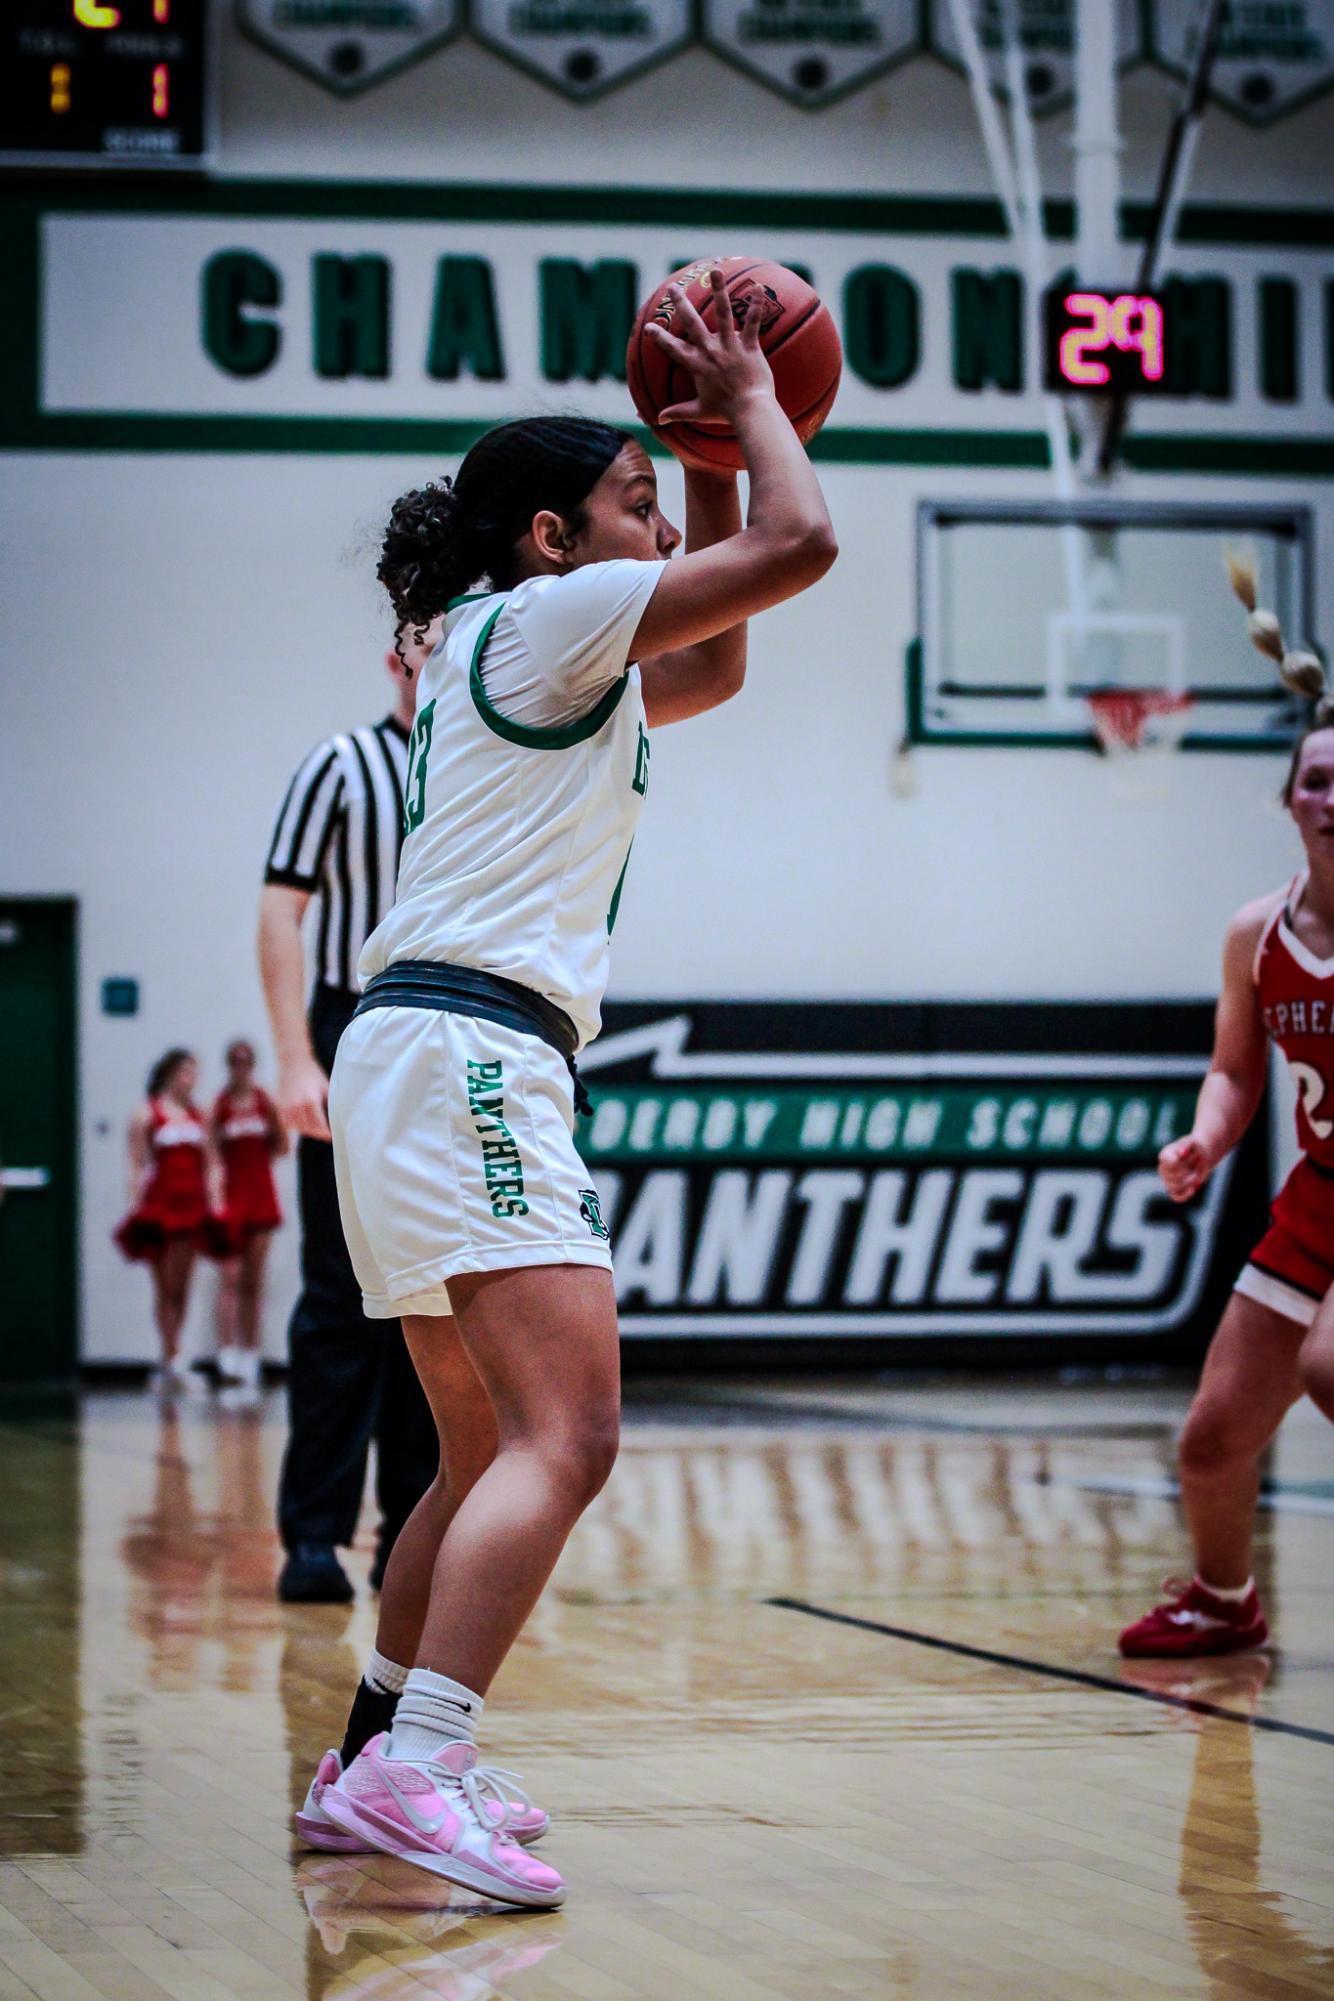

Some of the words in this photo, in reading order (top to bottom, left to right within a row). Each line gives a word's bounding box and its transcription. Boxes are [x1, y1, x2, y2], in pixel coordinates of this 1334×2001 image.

[203, 247, 1334, 403] CHAMONHI
[1059, 293, 1164, 385] 29
[404, 698, 437, 837] 3
[466, 1058, 530, 1219] PANTHERS
[590, 1098, 776, 1150] DERBY
[800, 1098, 942, 1150] HIGH
[966, 1098, 1177, 1150] SCHOOL
